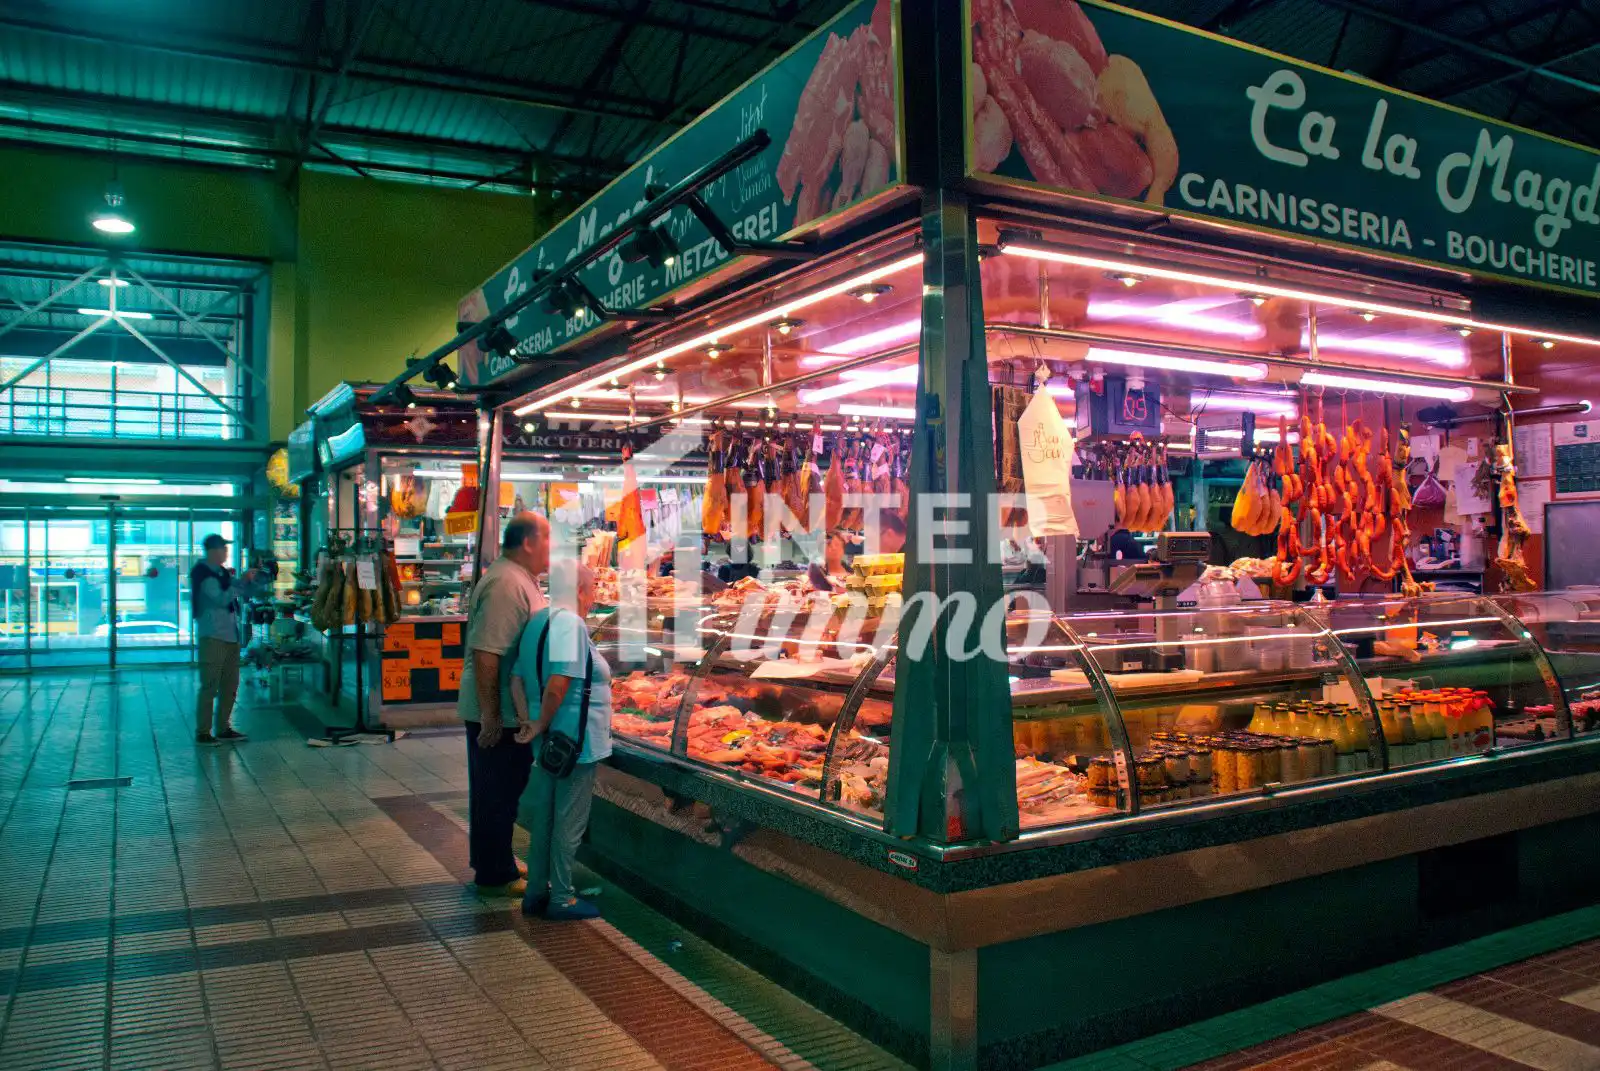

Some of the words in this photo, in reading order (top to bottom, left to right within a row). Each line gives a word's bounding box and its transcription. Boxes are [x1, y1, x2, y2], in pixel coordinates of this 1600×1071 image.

[1246, 69, 1339, 167] Ca
[1361, 98, 1421, 180] la
[1436, 128, 1600, 248] Magd
[1179, 172, 1413, 250] CARNISSERIA
[1447, 229, 1598, 288] BOUCHERIE
[490, 326, 553, 377] CARNSSERIA
